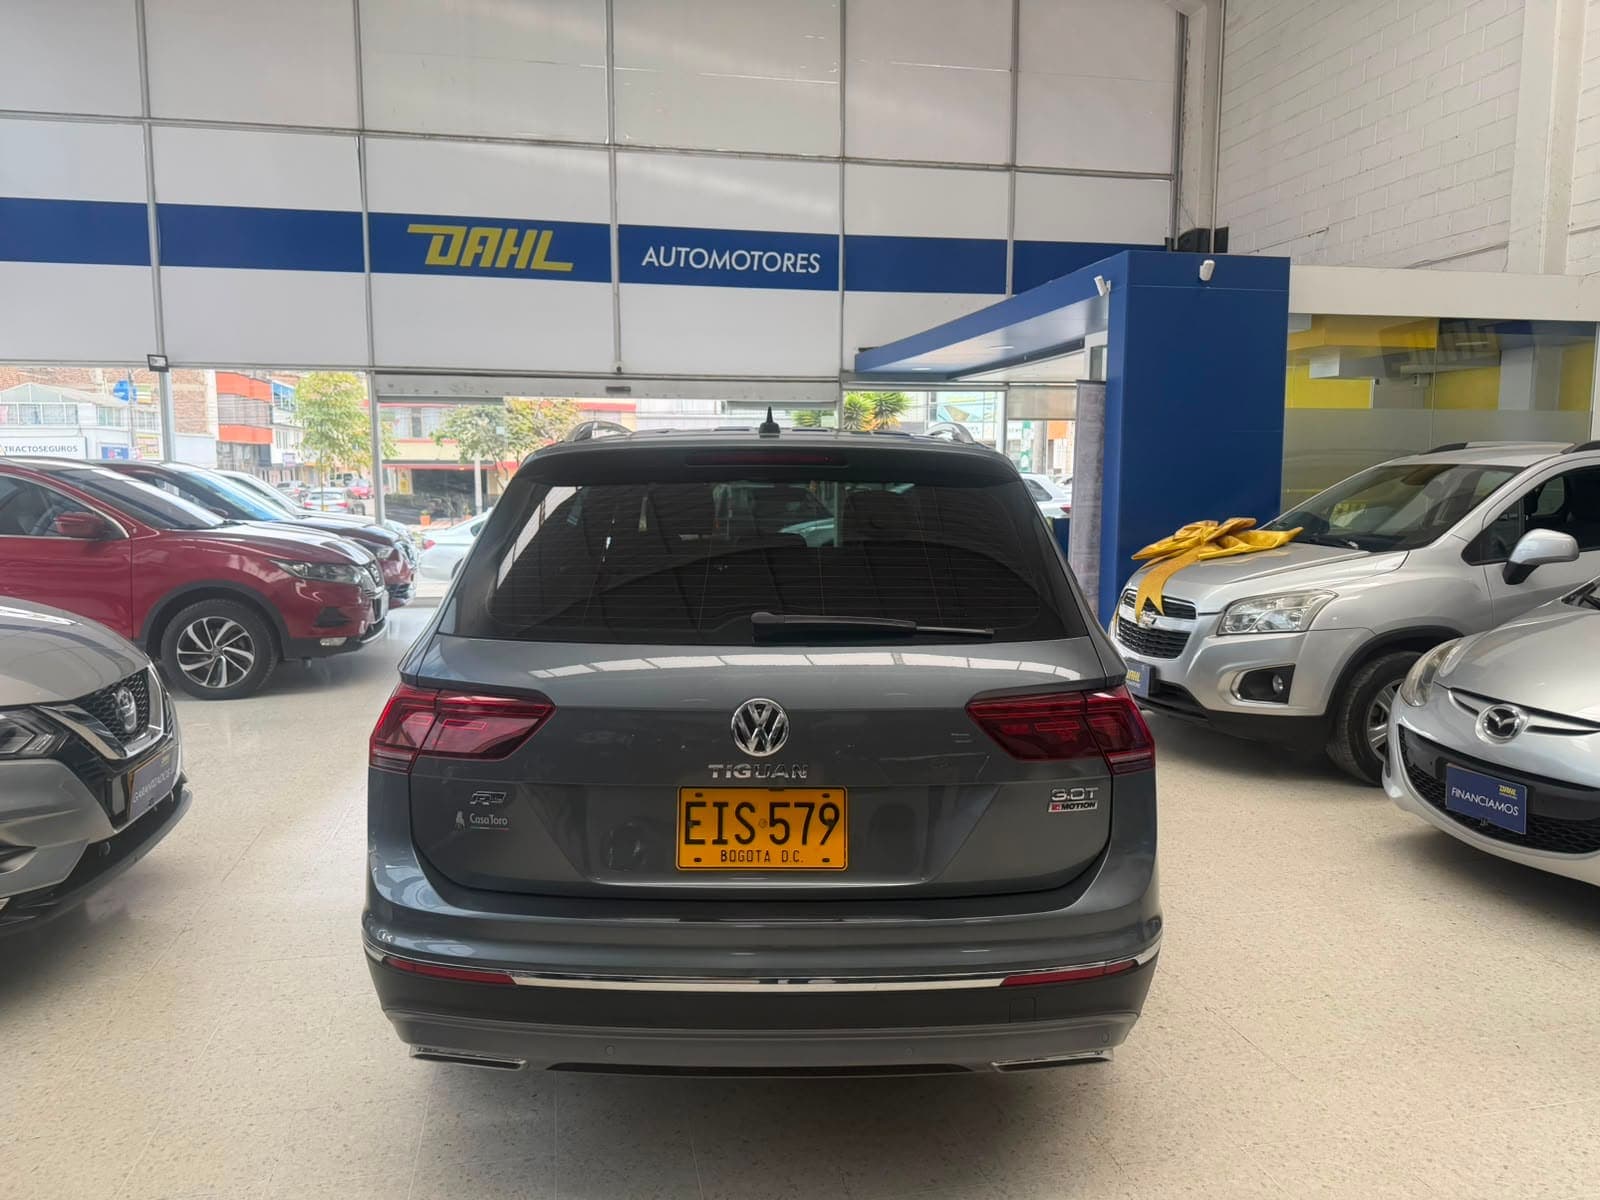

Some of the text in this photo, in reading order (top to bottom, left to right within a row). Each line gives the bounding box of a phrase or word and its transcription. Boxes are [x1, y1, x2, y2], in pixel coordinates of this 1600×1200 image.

[407, 223, 820, 275] DAHL AUTOMOTORES
[4, 445, 78, 453] TRACTOSEGUROS
[708, 763, 808, 779] TIGUAN
[1450, 787, 1520, 817] FINANCIAMOS
[684, 801, 841, 847] EIS 579
[720, 849, 804, 863] BOGOTA D.C.
